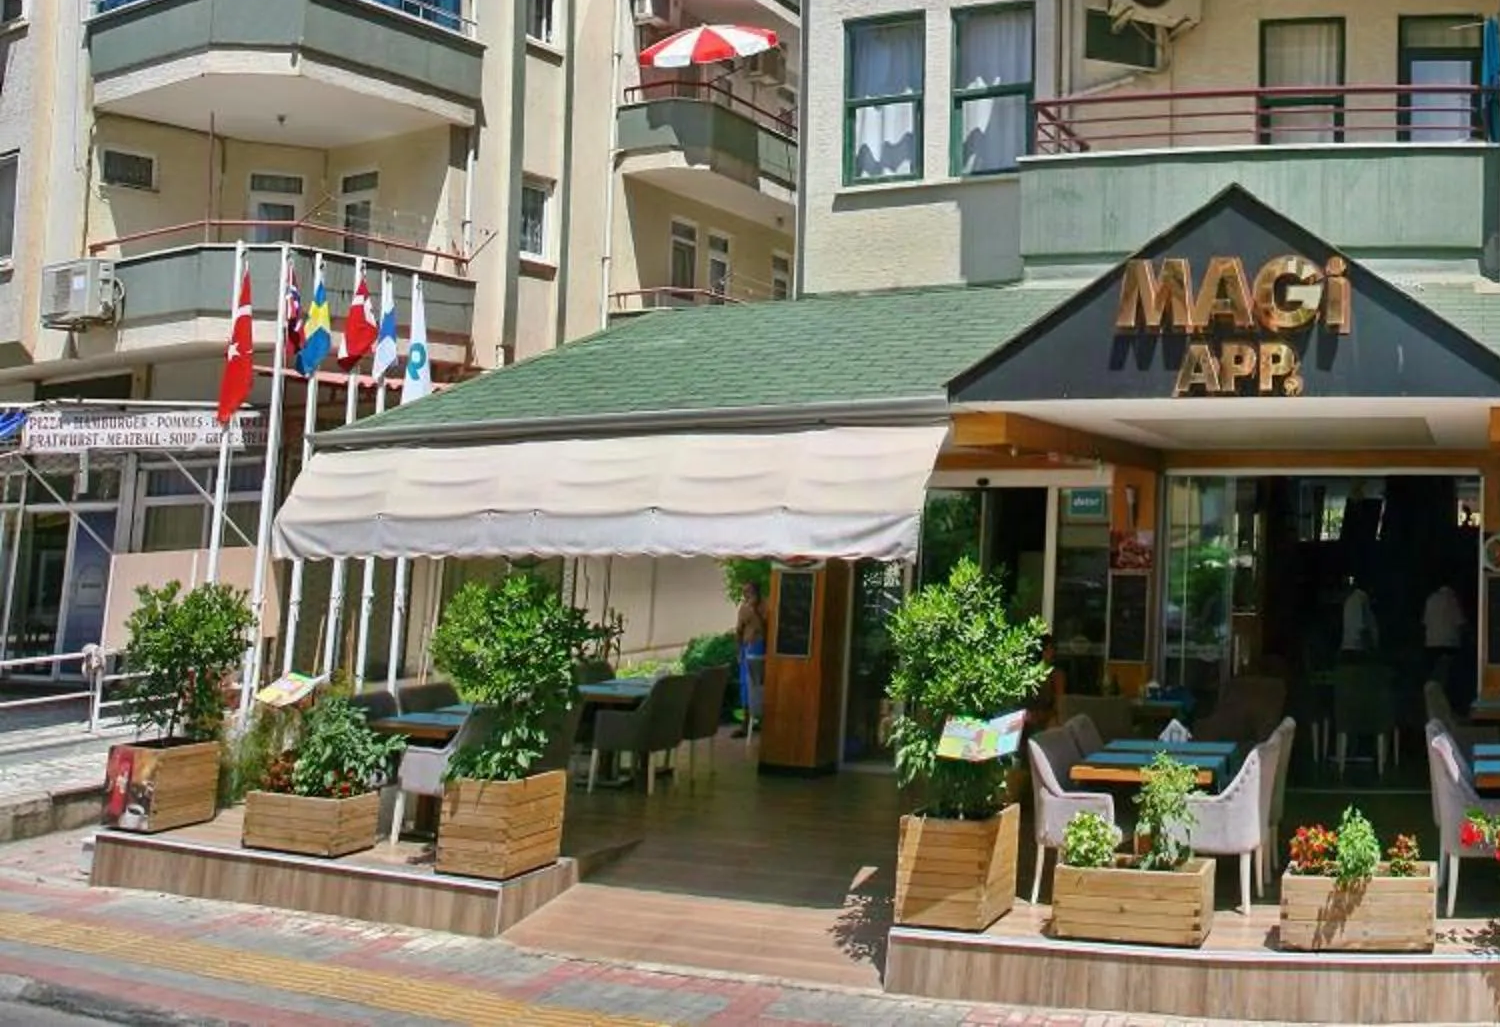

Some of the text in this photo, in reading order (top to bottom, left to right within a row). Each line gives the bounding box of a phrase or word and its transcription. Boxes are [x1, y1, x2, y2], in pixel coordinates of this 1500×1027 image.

[29, 415, 63, 431] PIZZA
[73, 415, 148, 431] HAMBURGER
[157, 415, 203, 430] POMMES
[106, 432, 160, 446] MEATBALL
[169, 432, 197, 446] SOUP
